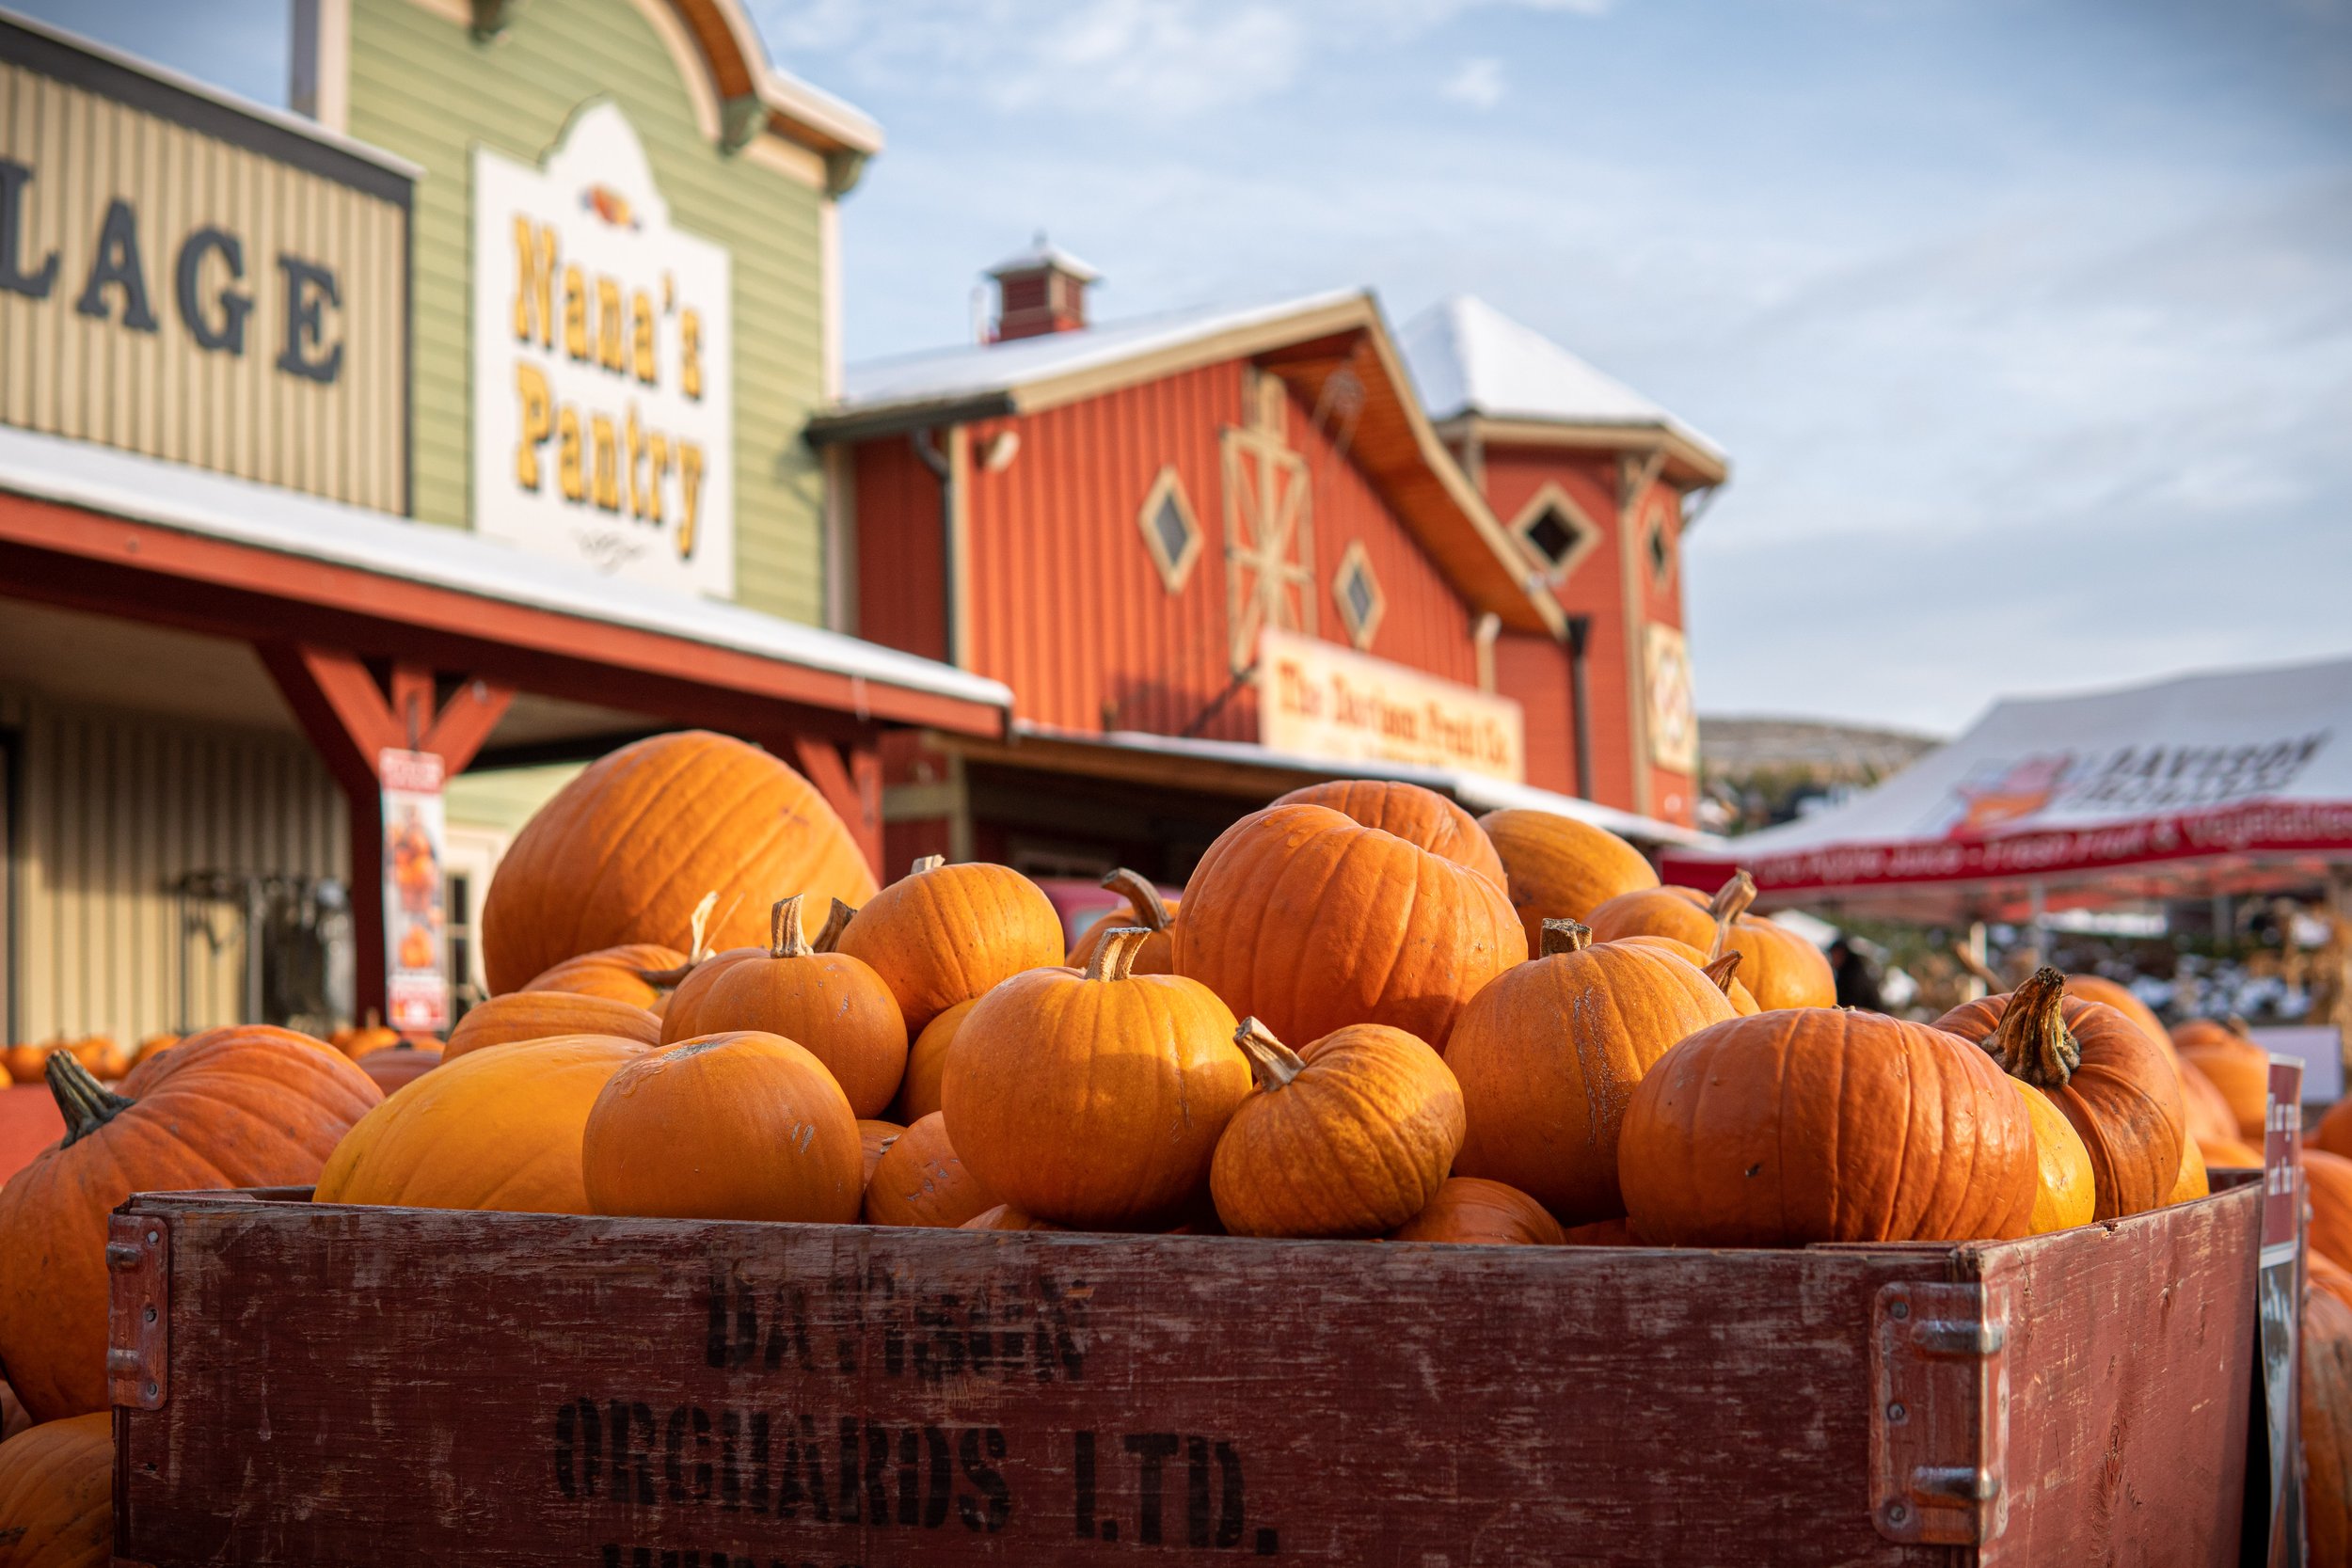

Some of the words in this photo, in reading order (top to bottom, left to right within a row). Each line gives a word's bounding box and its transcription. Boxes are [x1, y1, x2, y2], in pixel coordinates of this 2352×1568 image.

[512, 212, 705, 401] Nana's
[514, 360, 705, 562] Pantry
[555, 1397, 1012, 1534] ORCHARDS
[1075, 1432, 1279, 1557] LTD.
